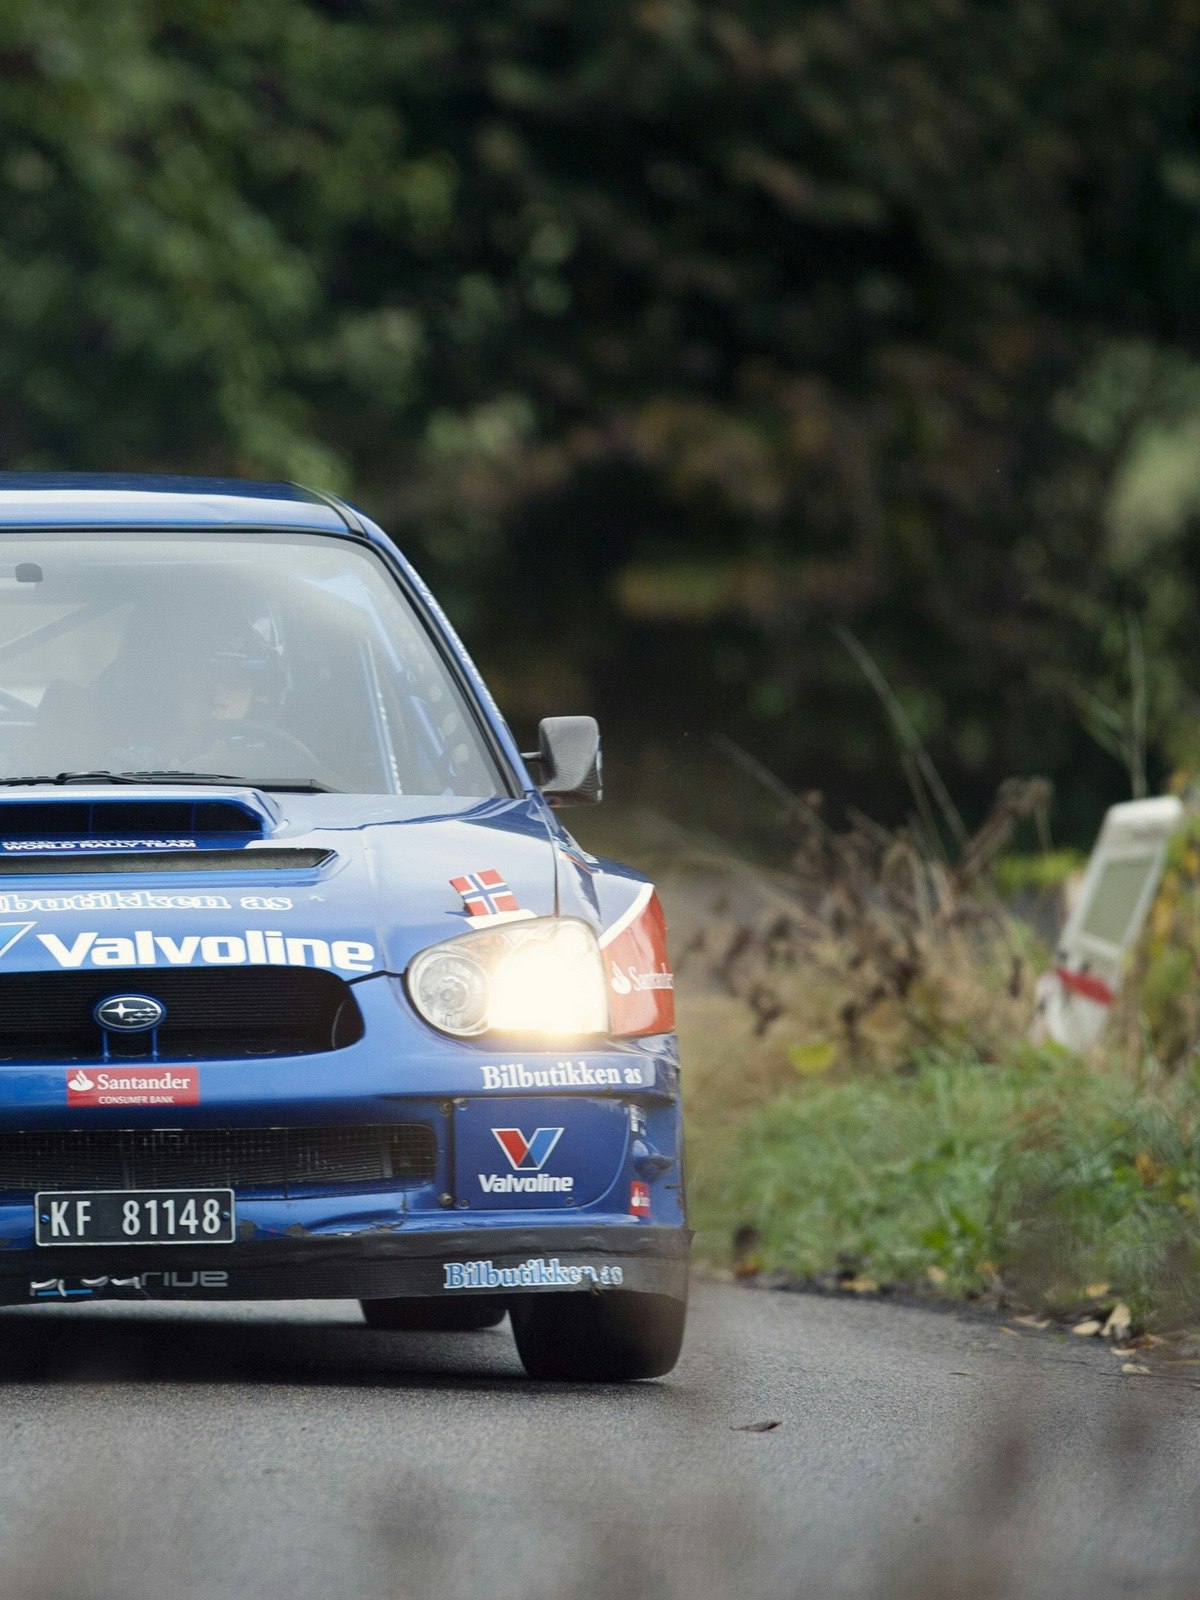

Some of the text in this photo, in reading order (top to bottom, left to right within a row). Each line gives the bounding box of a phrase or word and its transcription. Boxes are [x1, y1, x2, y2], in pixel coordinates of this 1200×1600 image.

[3, 842, 75, 851] WORLD
[79, 841, 137, 849] RALLY
[145, 840, 197, 849] TEAM
[240, 895, 293, 911] as
[35, 930, 375, 971] Valvoline
[97, 1072, 191, 1090] Santander
[480, 1061, 643, 1090] Bilbutikken as
[98, 1095, 175, 1105] CONSUMER BANK
[478, 1173, 574, 1192] Valvoline
[50, 1198, 221, 1237] KF 81148
